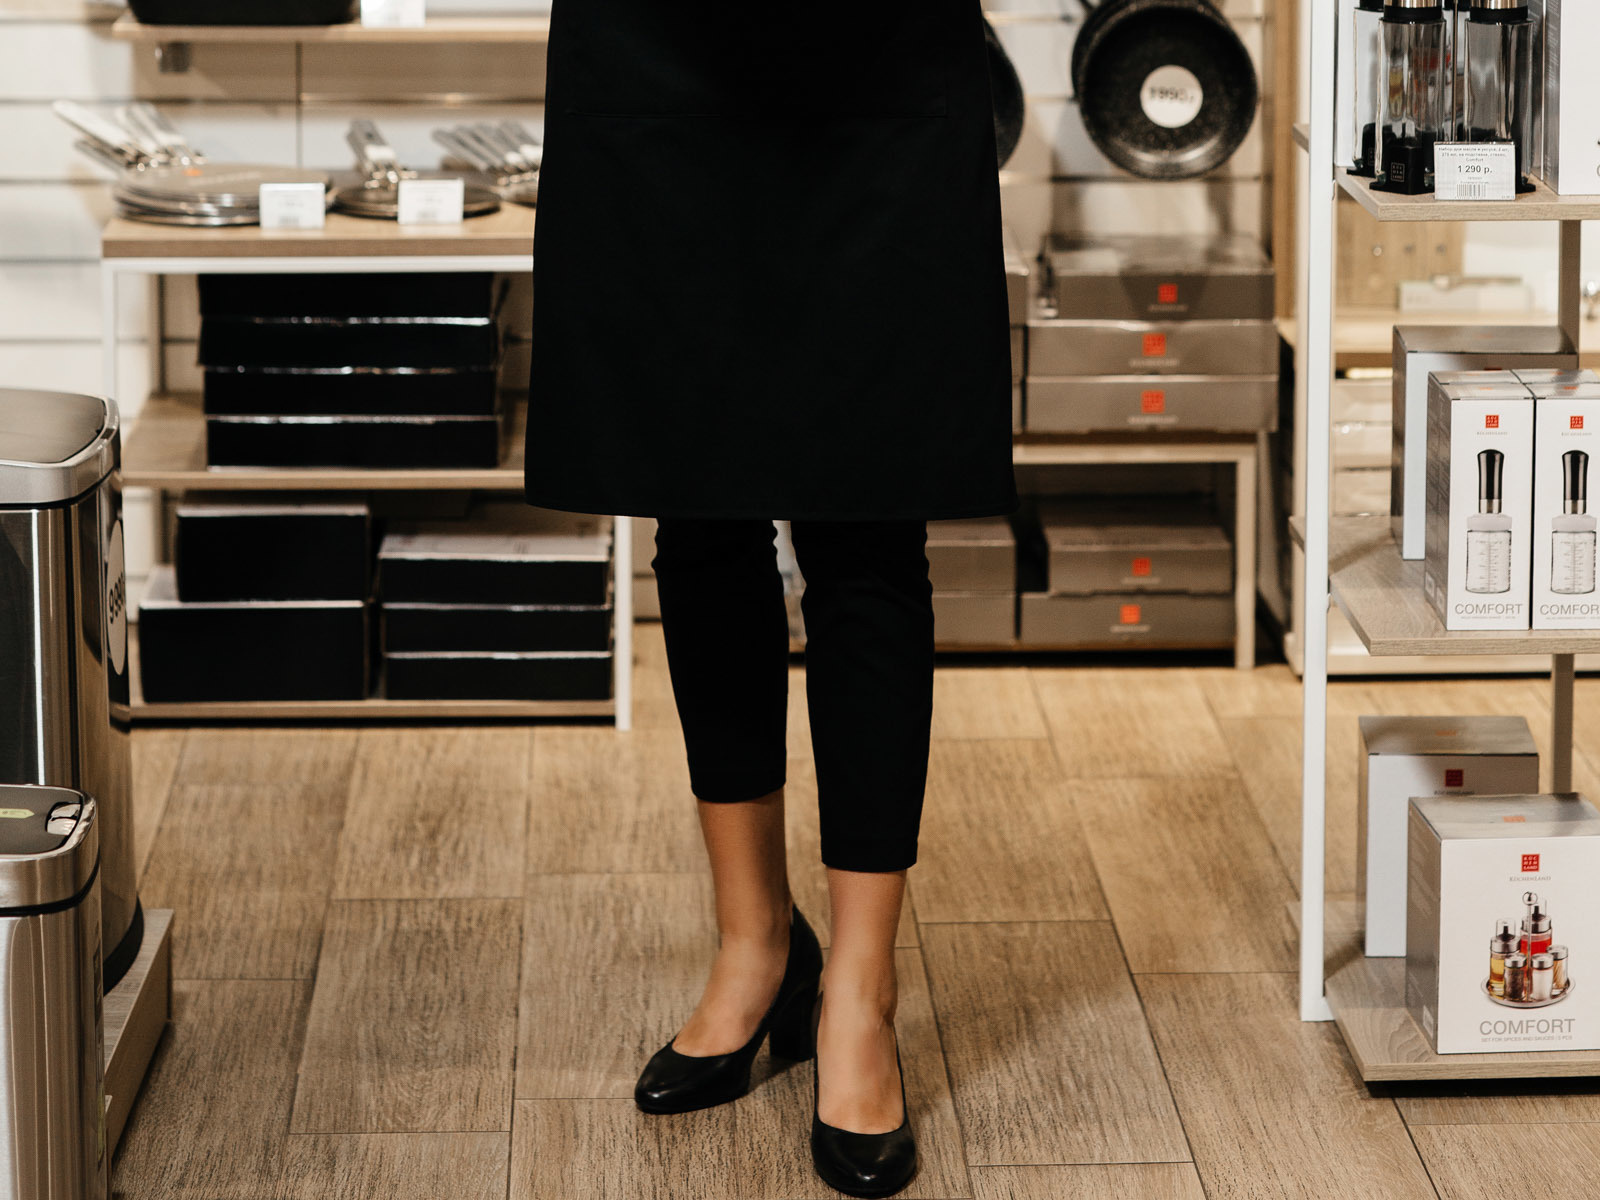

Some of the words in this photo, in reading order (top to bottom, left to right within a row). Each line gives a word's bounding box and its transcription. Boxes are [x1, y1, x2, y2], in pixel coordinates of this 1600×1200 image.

[1458, 165, 1462, 173] 1
[1465, 165, 1482, 173] 290
[1455, 604, 1523, 615] COMFORT
[1480, 1018, 1576, 1035] COMFORT
